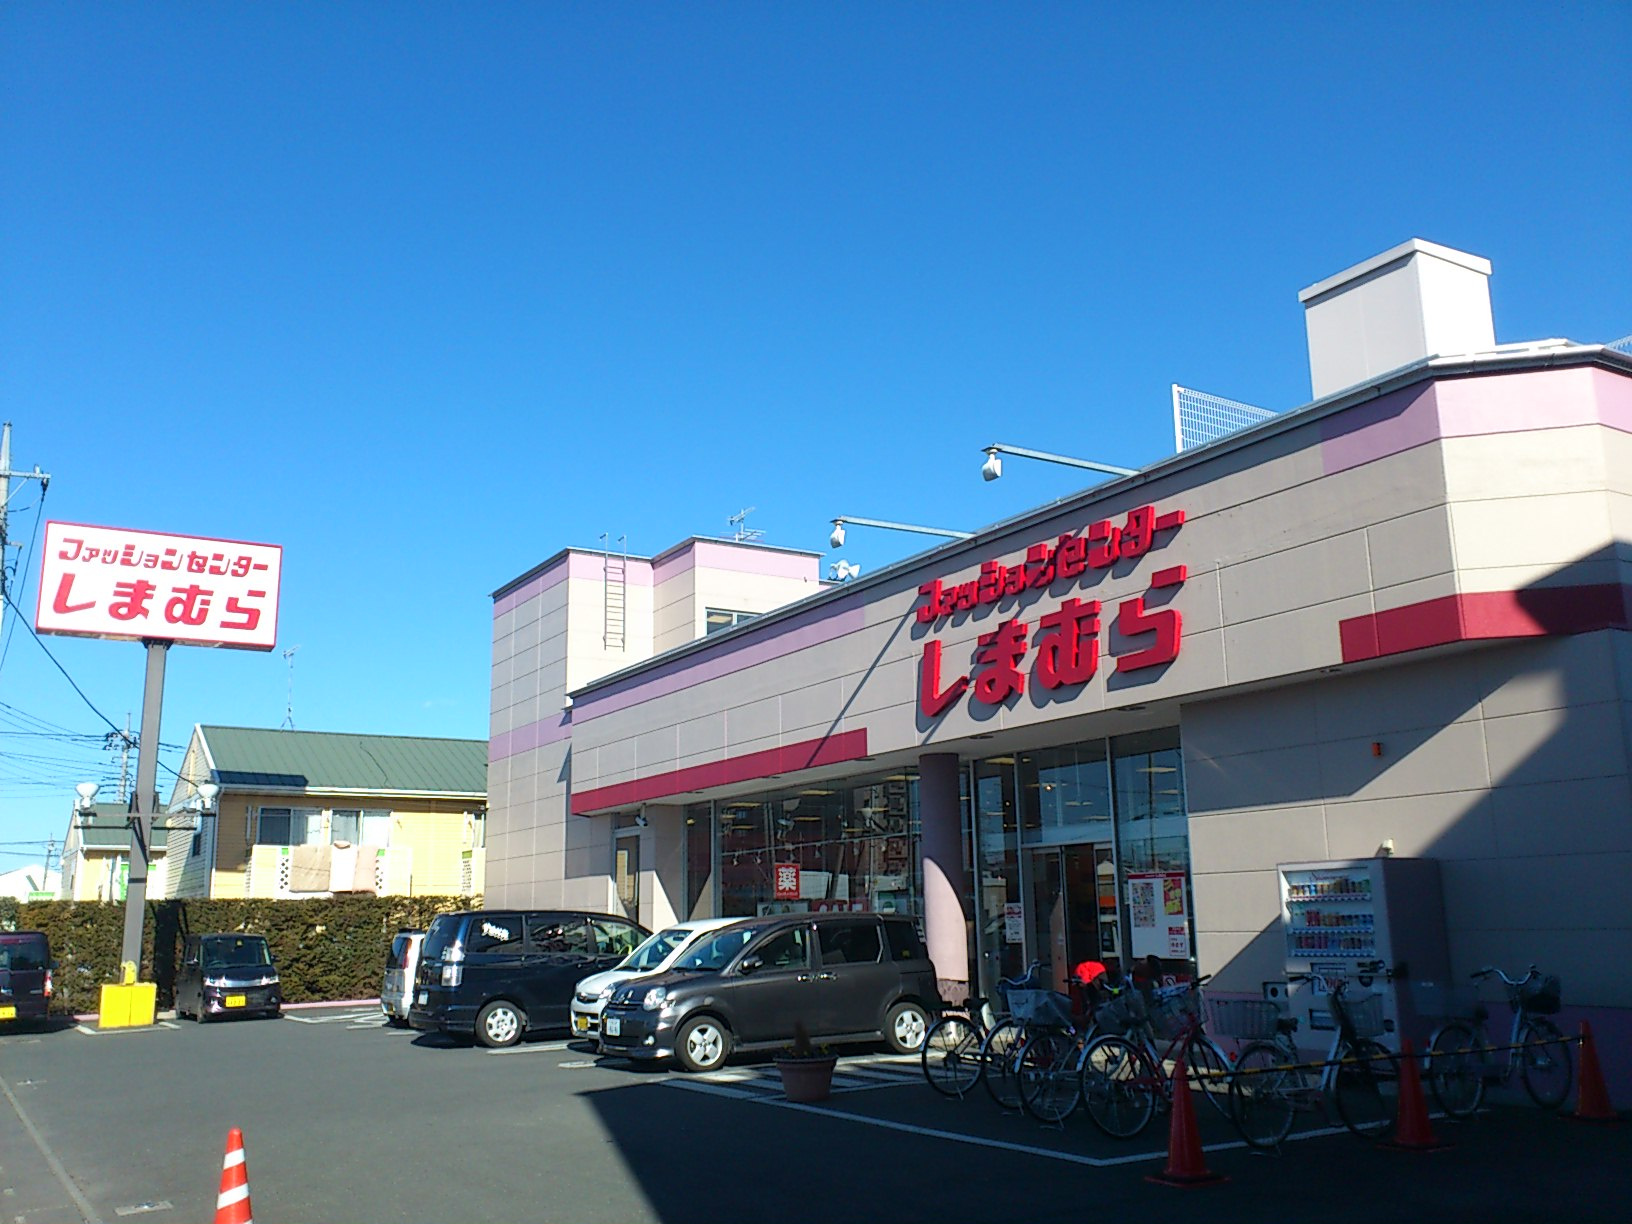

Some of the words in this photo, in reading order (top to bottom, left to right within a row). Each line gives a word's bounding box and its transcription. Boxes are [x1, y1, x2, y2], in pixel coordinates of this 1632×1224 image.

[53, 572, 266, 631] しまむら
[58, 538, 269, 577] ファッションセンター
[917, 505, 1186, 623] ファッションセンター
[922, 564, 1187, 717] しまむら
